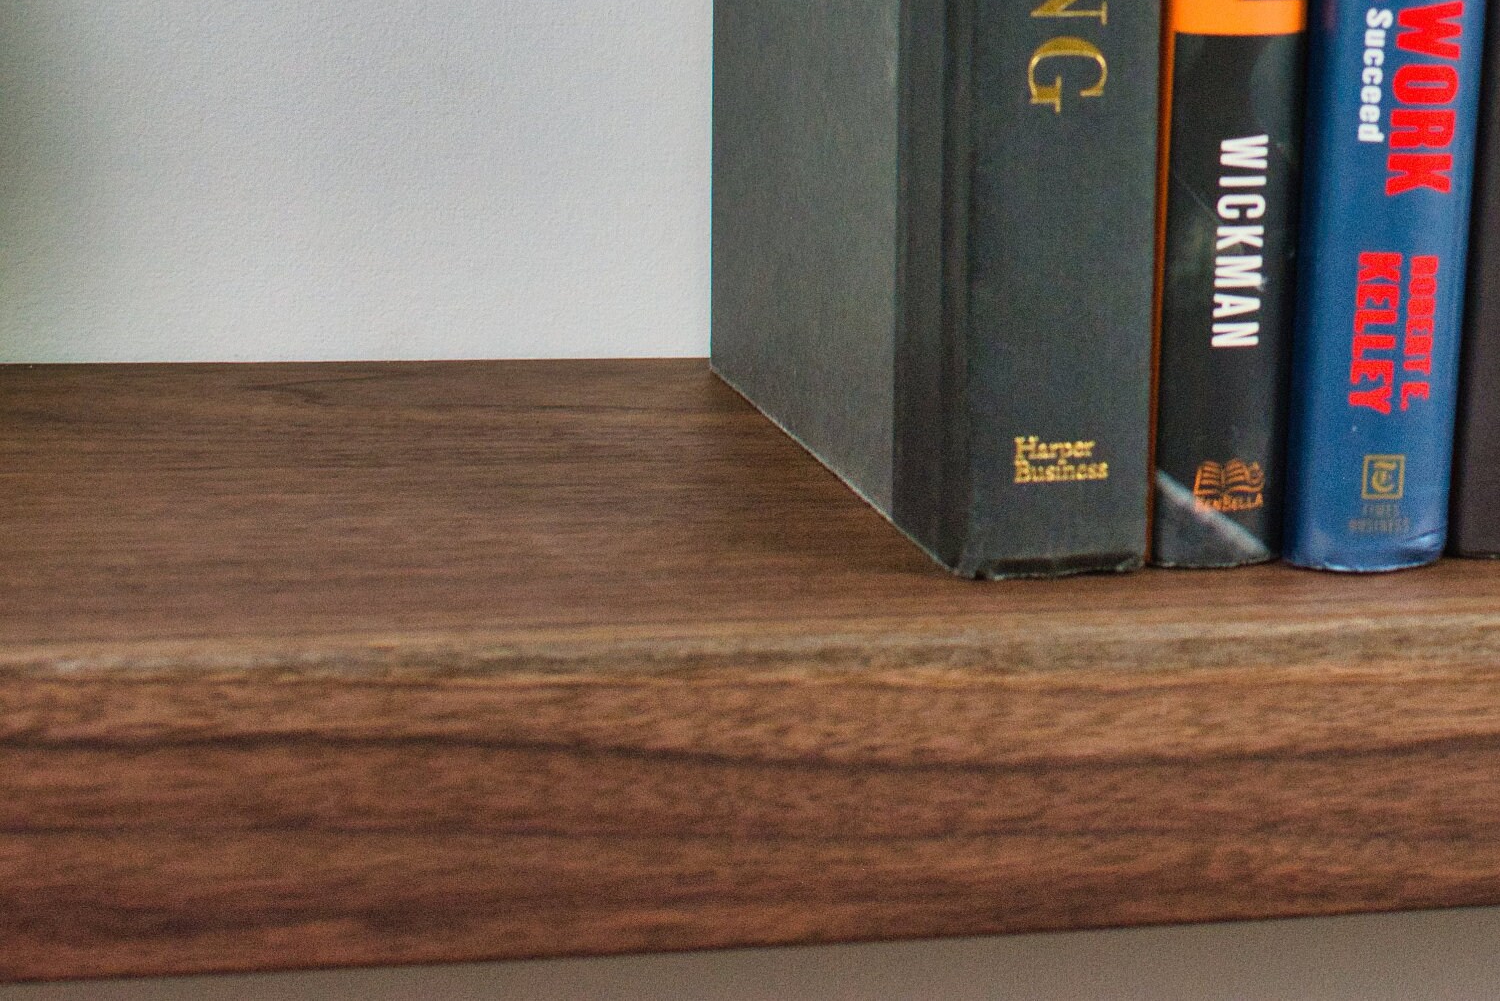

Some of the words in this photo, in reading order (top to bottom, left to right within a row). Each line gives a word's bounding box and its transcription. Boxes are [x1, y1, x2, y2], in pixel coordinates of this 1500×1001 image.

[1358, 8, 1393, 143] Succeed
[1386, 0, 1465, 196] WORK
[1211, 134, 1269, 347] WICKMAN
[1348, 252, 1402, 414] KELLEY
[1403, 254, 1439, 375] ROBERT
[1013, 435, 1095, 464] Harper
[1400, 381, 1430, 412] E.
[1013, 460, 1109, 484] Business
